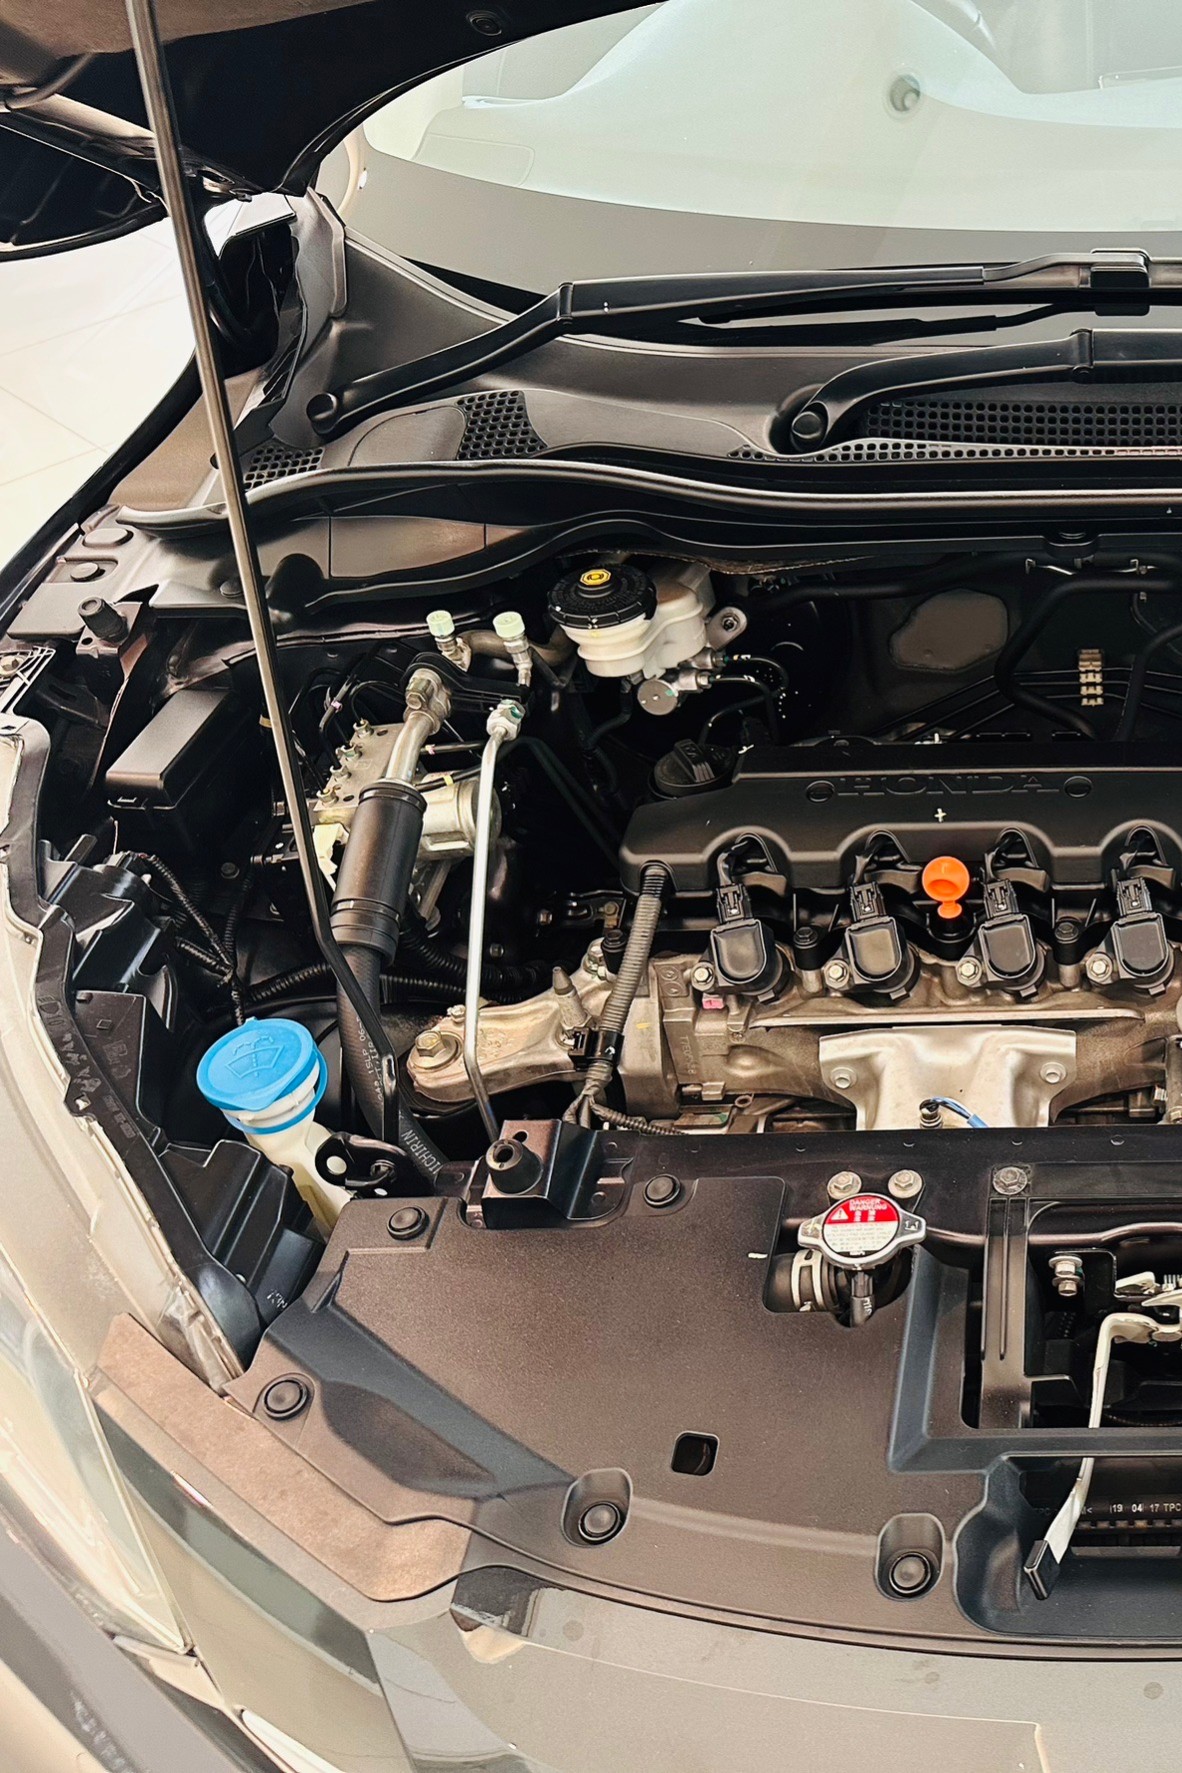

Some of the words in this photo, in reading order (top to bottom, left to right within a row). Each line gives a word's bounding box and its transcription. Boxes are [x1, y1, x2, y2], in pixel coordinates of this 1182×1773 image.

[837, 775, 1060, 795] HONDA
[1150, 1503, 1160, 1513] 17
[1163, 1503, 1182, 1512] TPC
